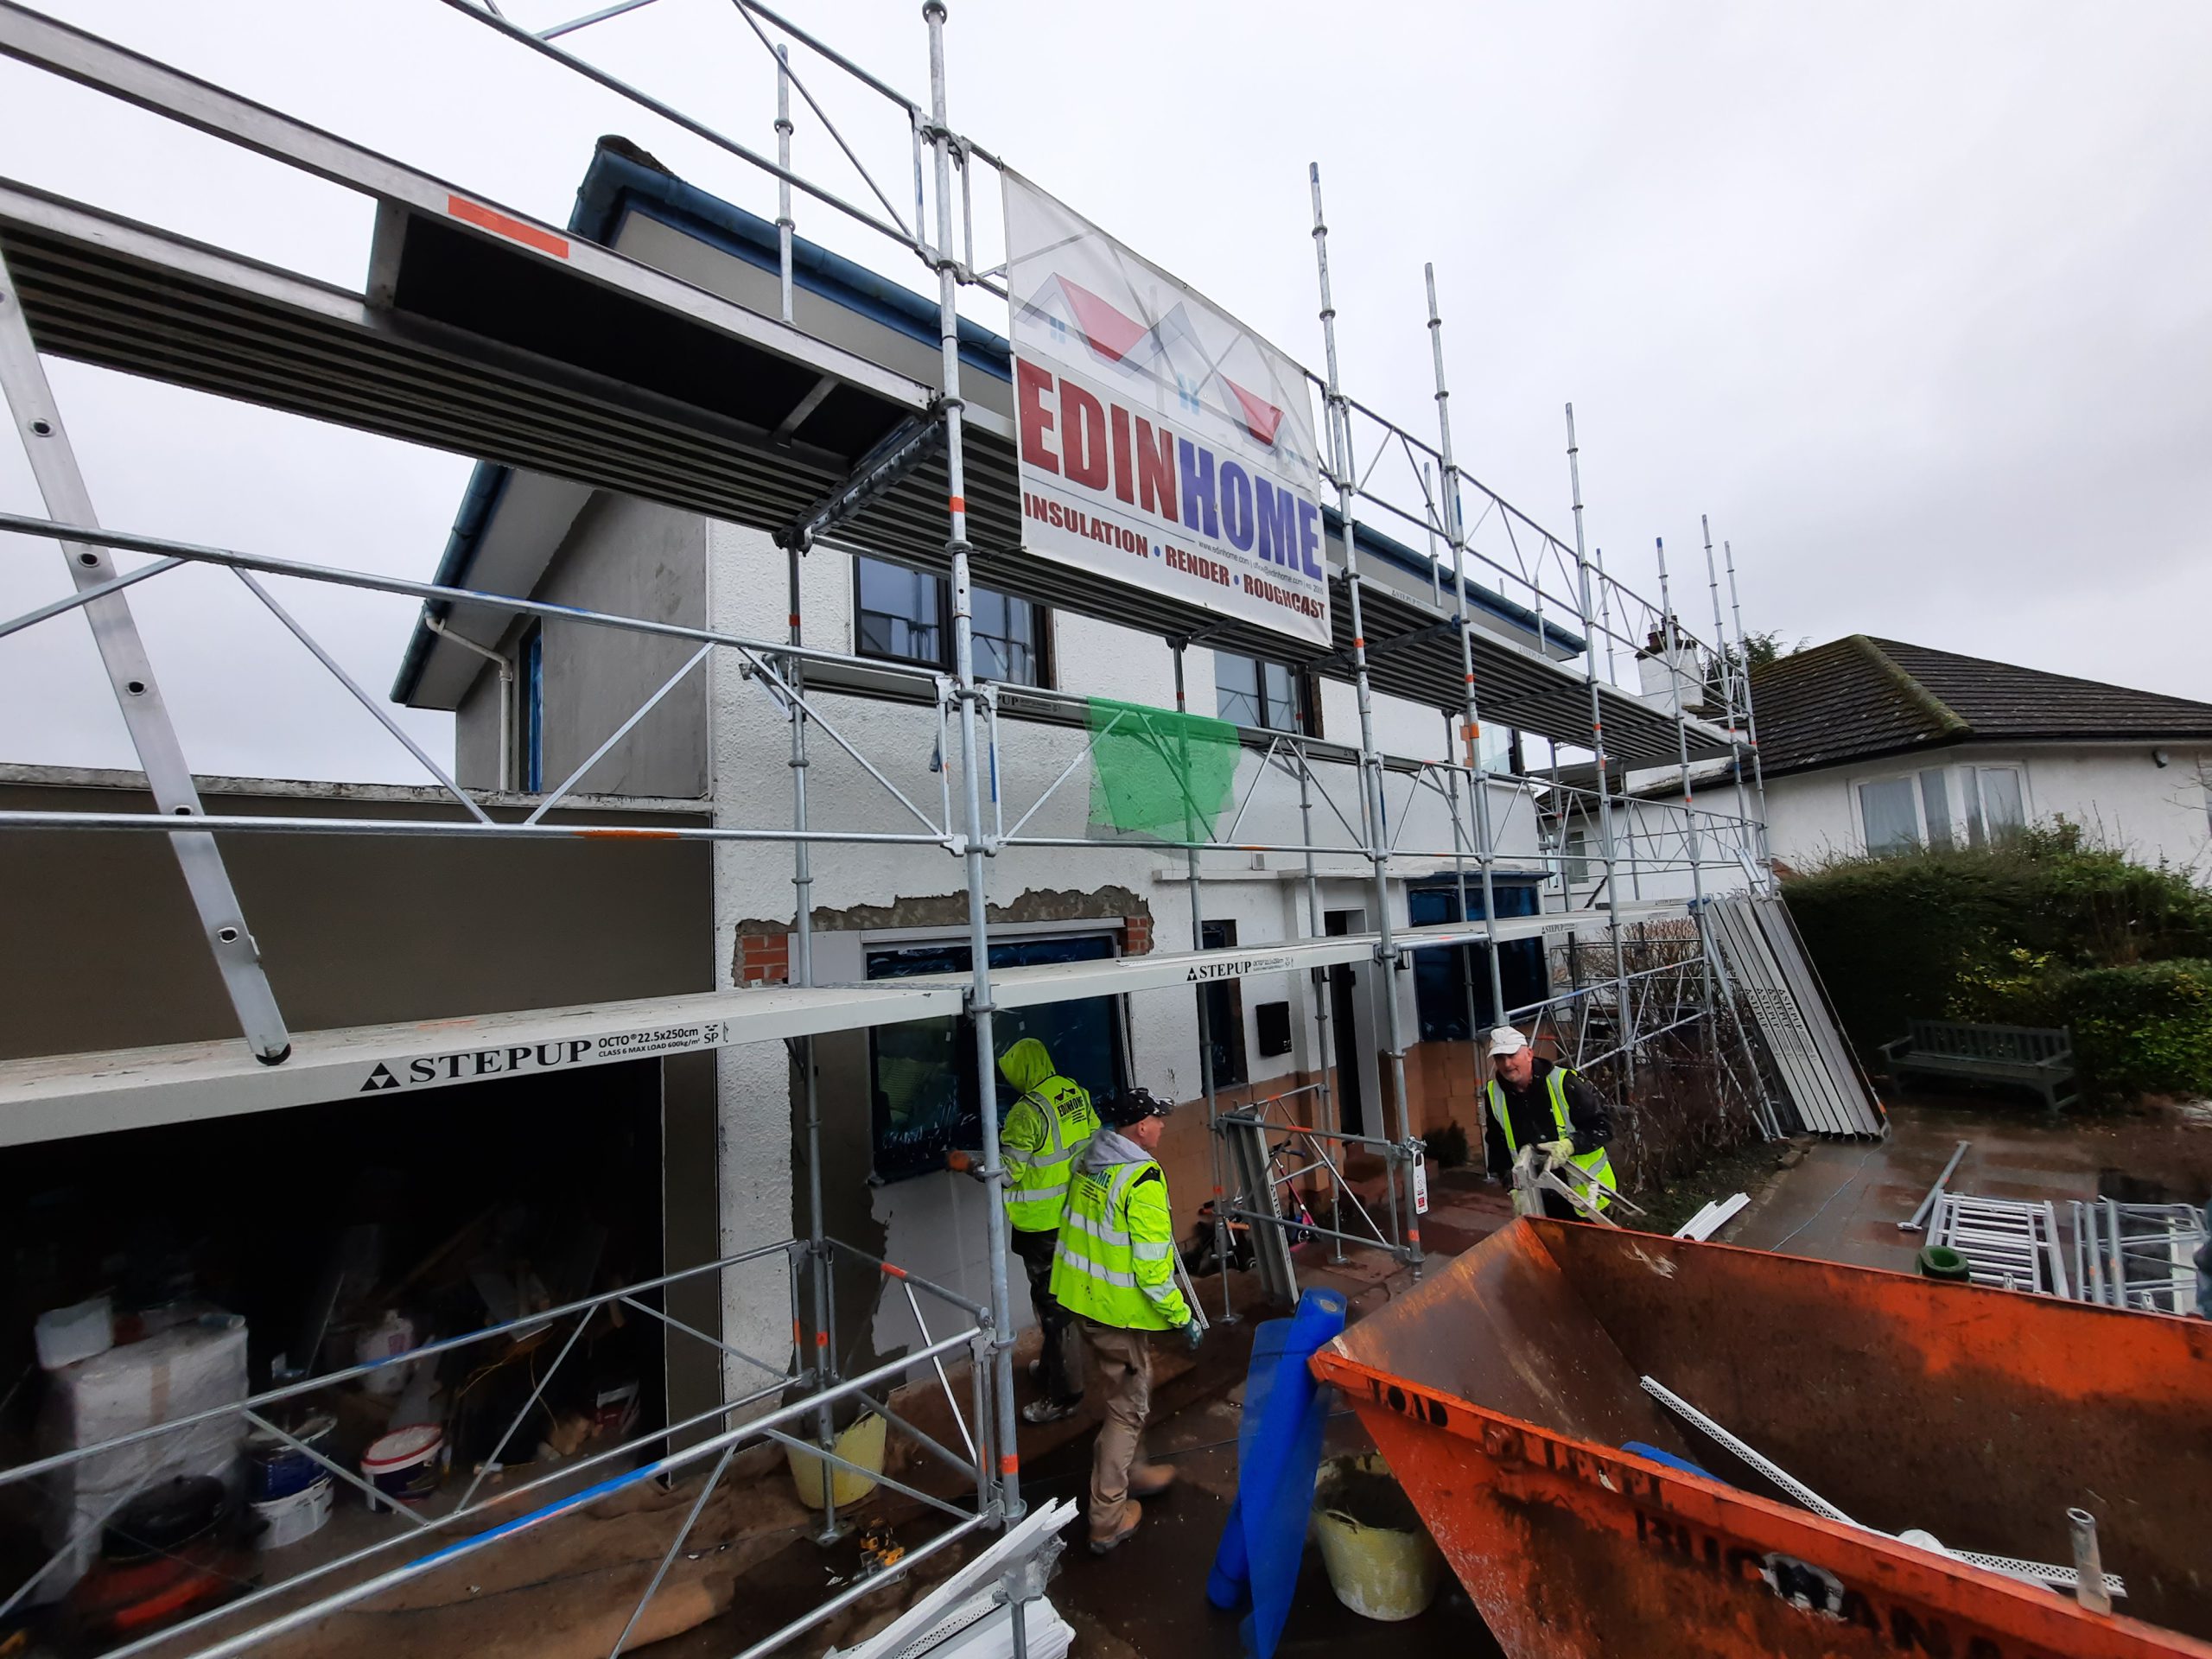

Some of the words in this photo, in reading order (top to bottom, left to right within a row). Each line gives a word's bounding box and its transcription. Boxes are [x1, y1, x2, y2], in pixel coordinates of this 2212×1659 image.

[1016, 357, 1323, 582] EDINHOME
[1024, 492, 1148, 558] INSULATION
[1166, 545, 1230, 587] RENDER
[1244, 575, 1325, 620] ROUGHCAST
[1199, 961, 1251, 978] STEPUP
[1750, 995, 1769, 1028] STEPUP
[1761, 995, 1780, 1028] STEPUP
[1772, 995, 1791, 1029] STEPUP
[1783, 995, 1803, 1030] STEPUP
[598, 1047, 621, 1058] CLASS
[628, 1045, 646, 1053] MAX
[647, 1043, 666, 1052] LOAD
[638, 1028, 699, 1043] 22.5x250cm
[410, 1039, 592, 1084] STEPUP
